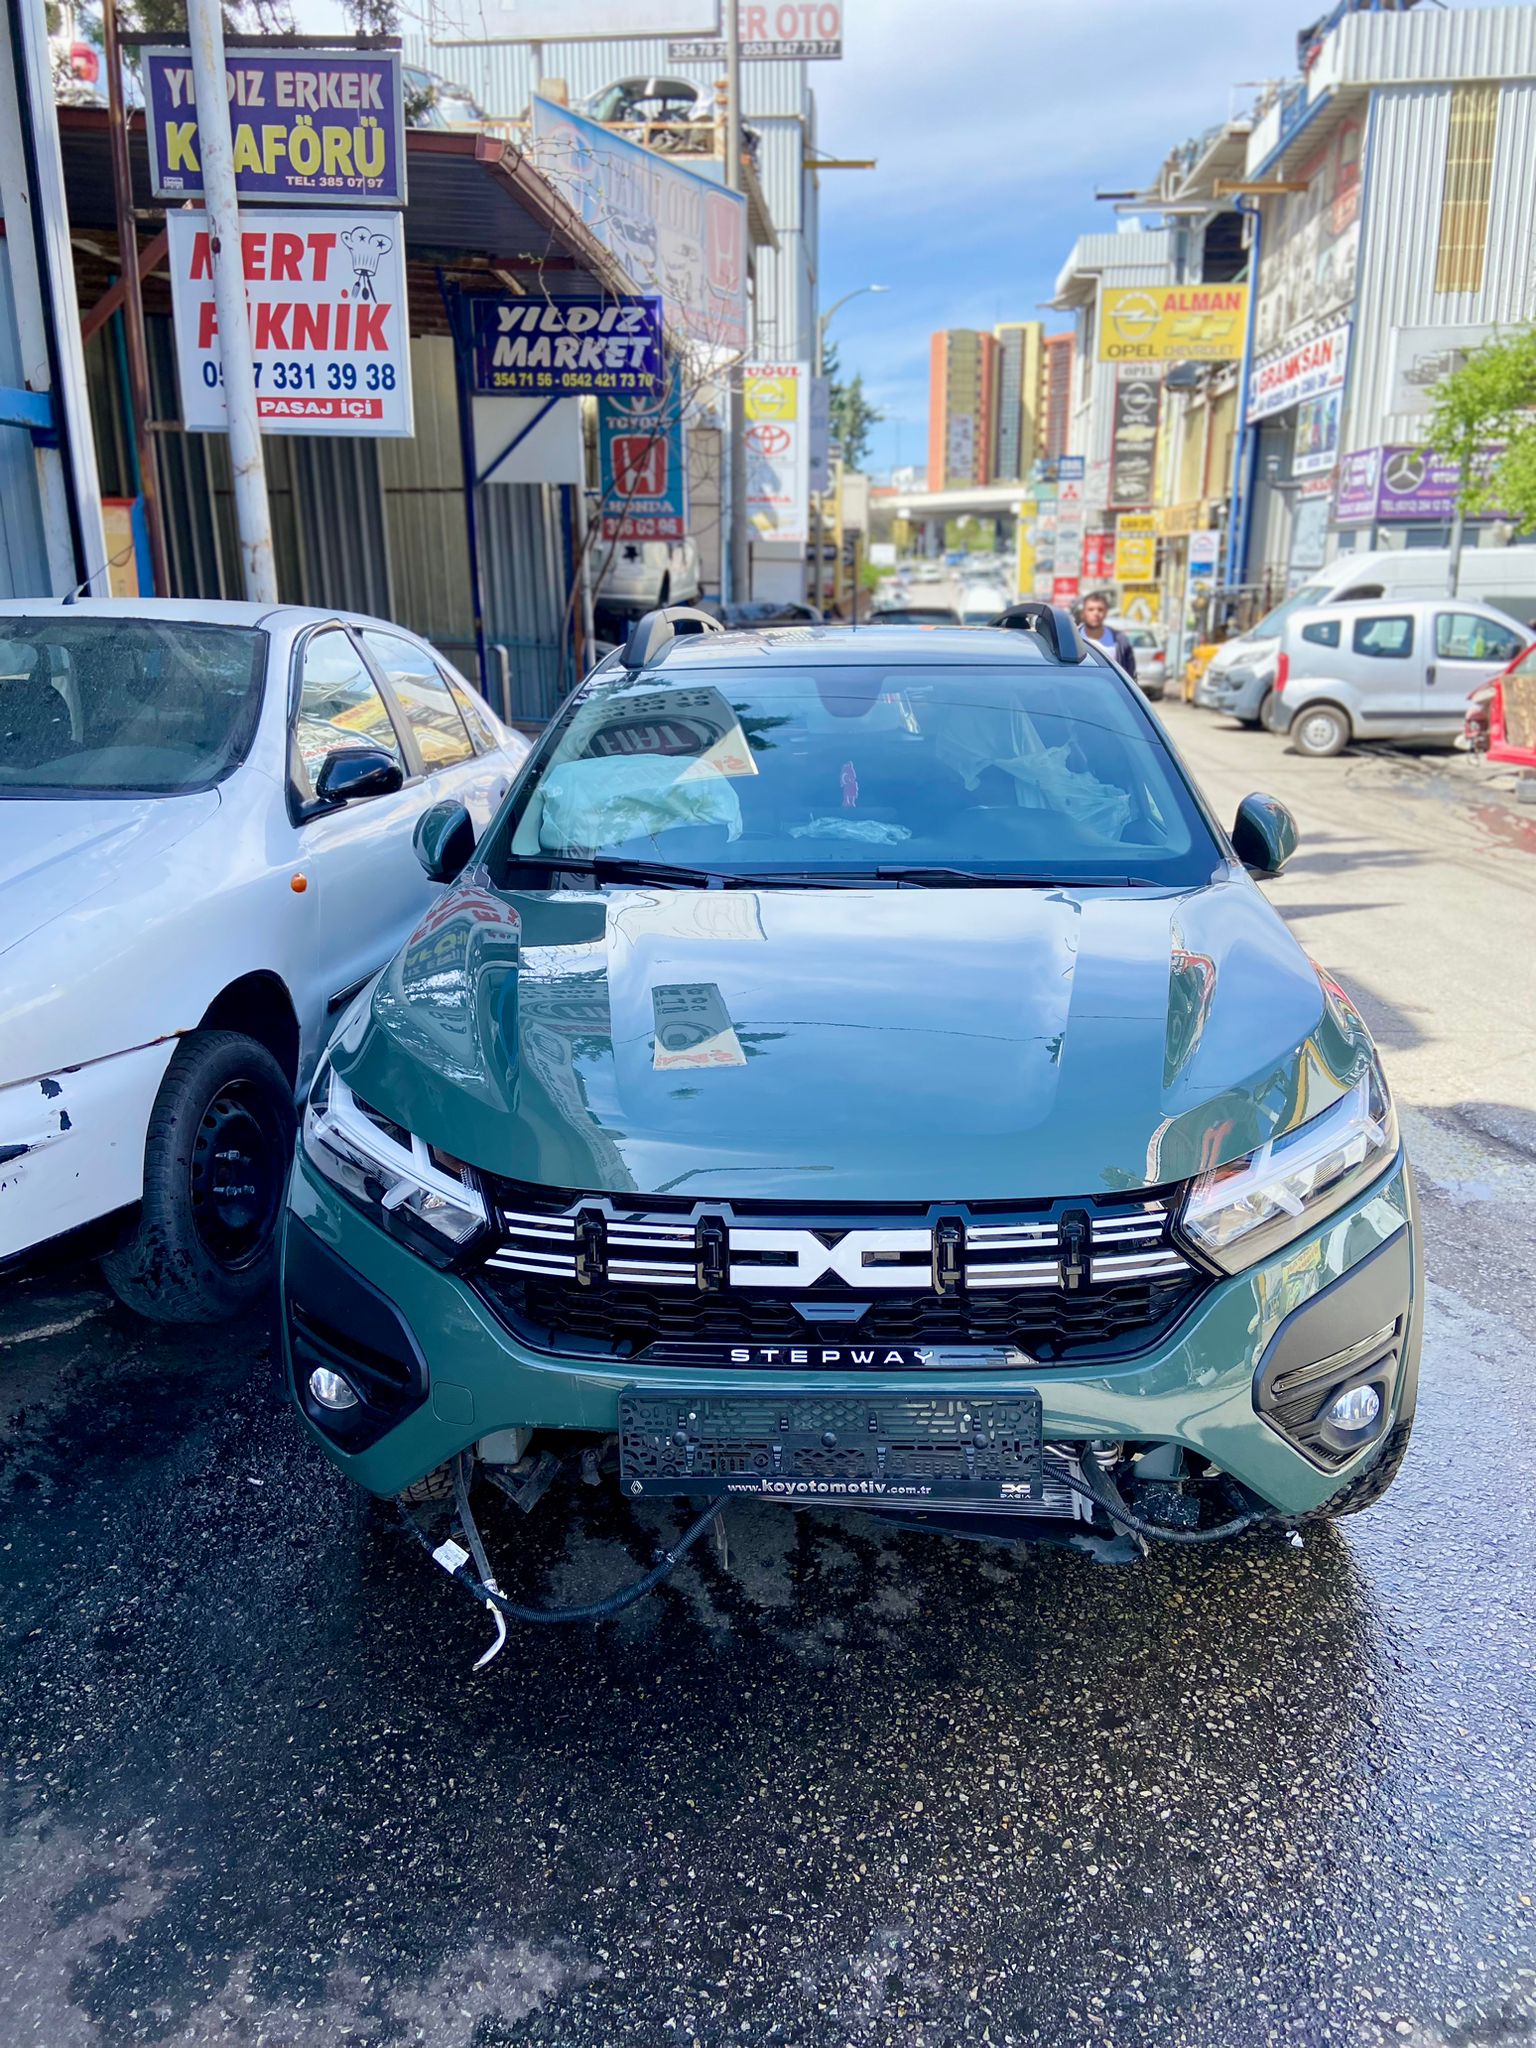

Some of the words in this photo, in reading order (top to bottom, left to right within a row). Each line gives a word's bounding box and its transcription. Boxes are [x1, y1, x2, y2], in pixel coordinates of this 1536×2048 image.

[775, 3, 840, 41] OTO
[672, 45, 695, 57] 354
[821, 42, 835, 53] 77
[164, 68, 265, 109] YIIZ
[275, 71, 385, 112] ERKEK
[165, 114, 386, 178] KAFÖRÜ
[285, 176, 316, 187] TEL:
[319, 176, 345, 187] 385
[347, 177, 364, 187] 07
[367, 177, 385, 188] 97
[1163, 292, 1242, 312] ALMAN
[198, 288, 393, 351] PKNİK
[497, 306, 647, 333] YILDIZ
[492, 336, 652, 370] MARKET
[1107, 343, 1160, 358] OPEL
[203, 360, 263, 389] 07
[273, 362, 316, 390] 331
[327, 362, 357, 390] 39
[366, 363, 397, 391] 38
[493, 373, 517, 387] 354
[519, 373, 534, 387] 71
[537, 373, 553, 387] 56
[562, 373, 592, 387] 0542
[595, 373, 617, 387] 421
[620, 373, 635, 387] 73
[638, 373, 654, 388] 70
[1124, 365, 1155, 377] OPEL
[261, 401, 334, 415] PASAJ
[340, 399, 372, 418] İÇİ
[729, 1348, 935, 1366] STEPWAY
[727, 1479, 932, 1496] www.koyotomotiv.com.tr
